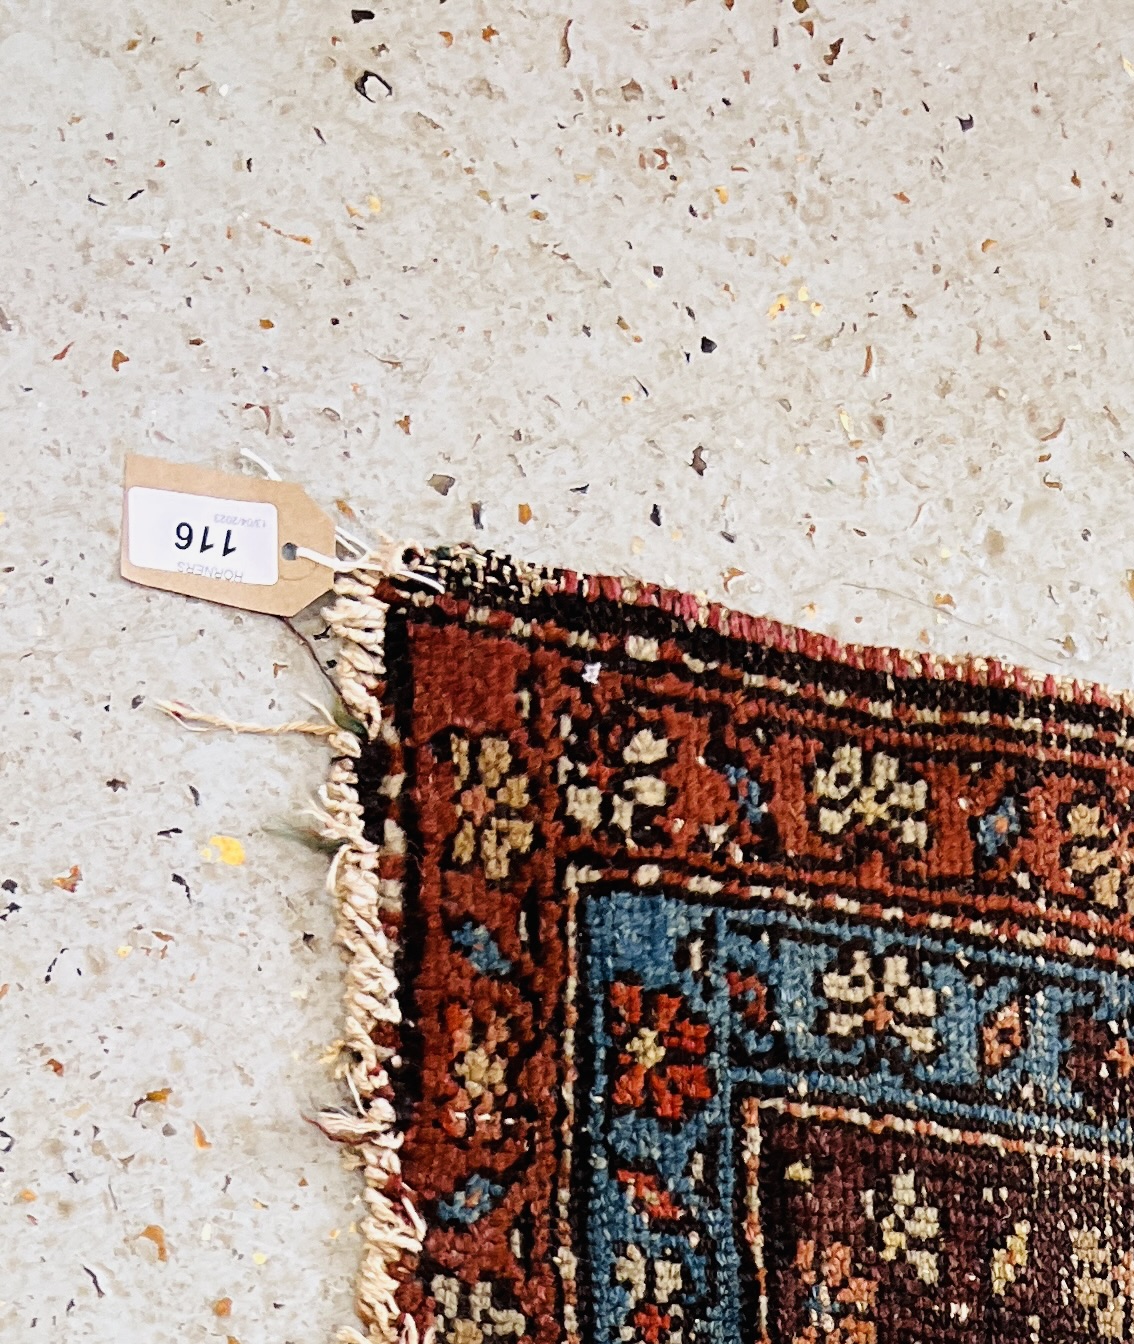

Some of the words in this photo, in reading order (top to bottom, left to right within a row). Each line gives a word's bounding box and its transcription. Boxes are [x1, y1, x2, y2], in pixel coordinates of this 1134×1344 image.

[213, 513, 267, 528] 13/04/2023
[174, 521, 237, 557] 116
[176, 561, 244, 583] HORNERS
